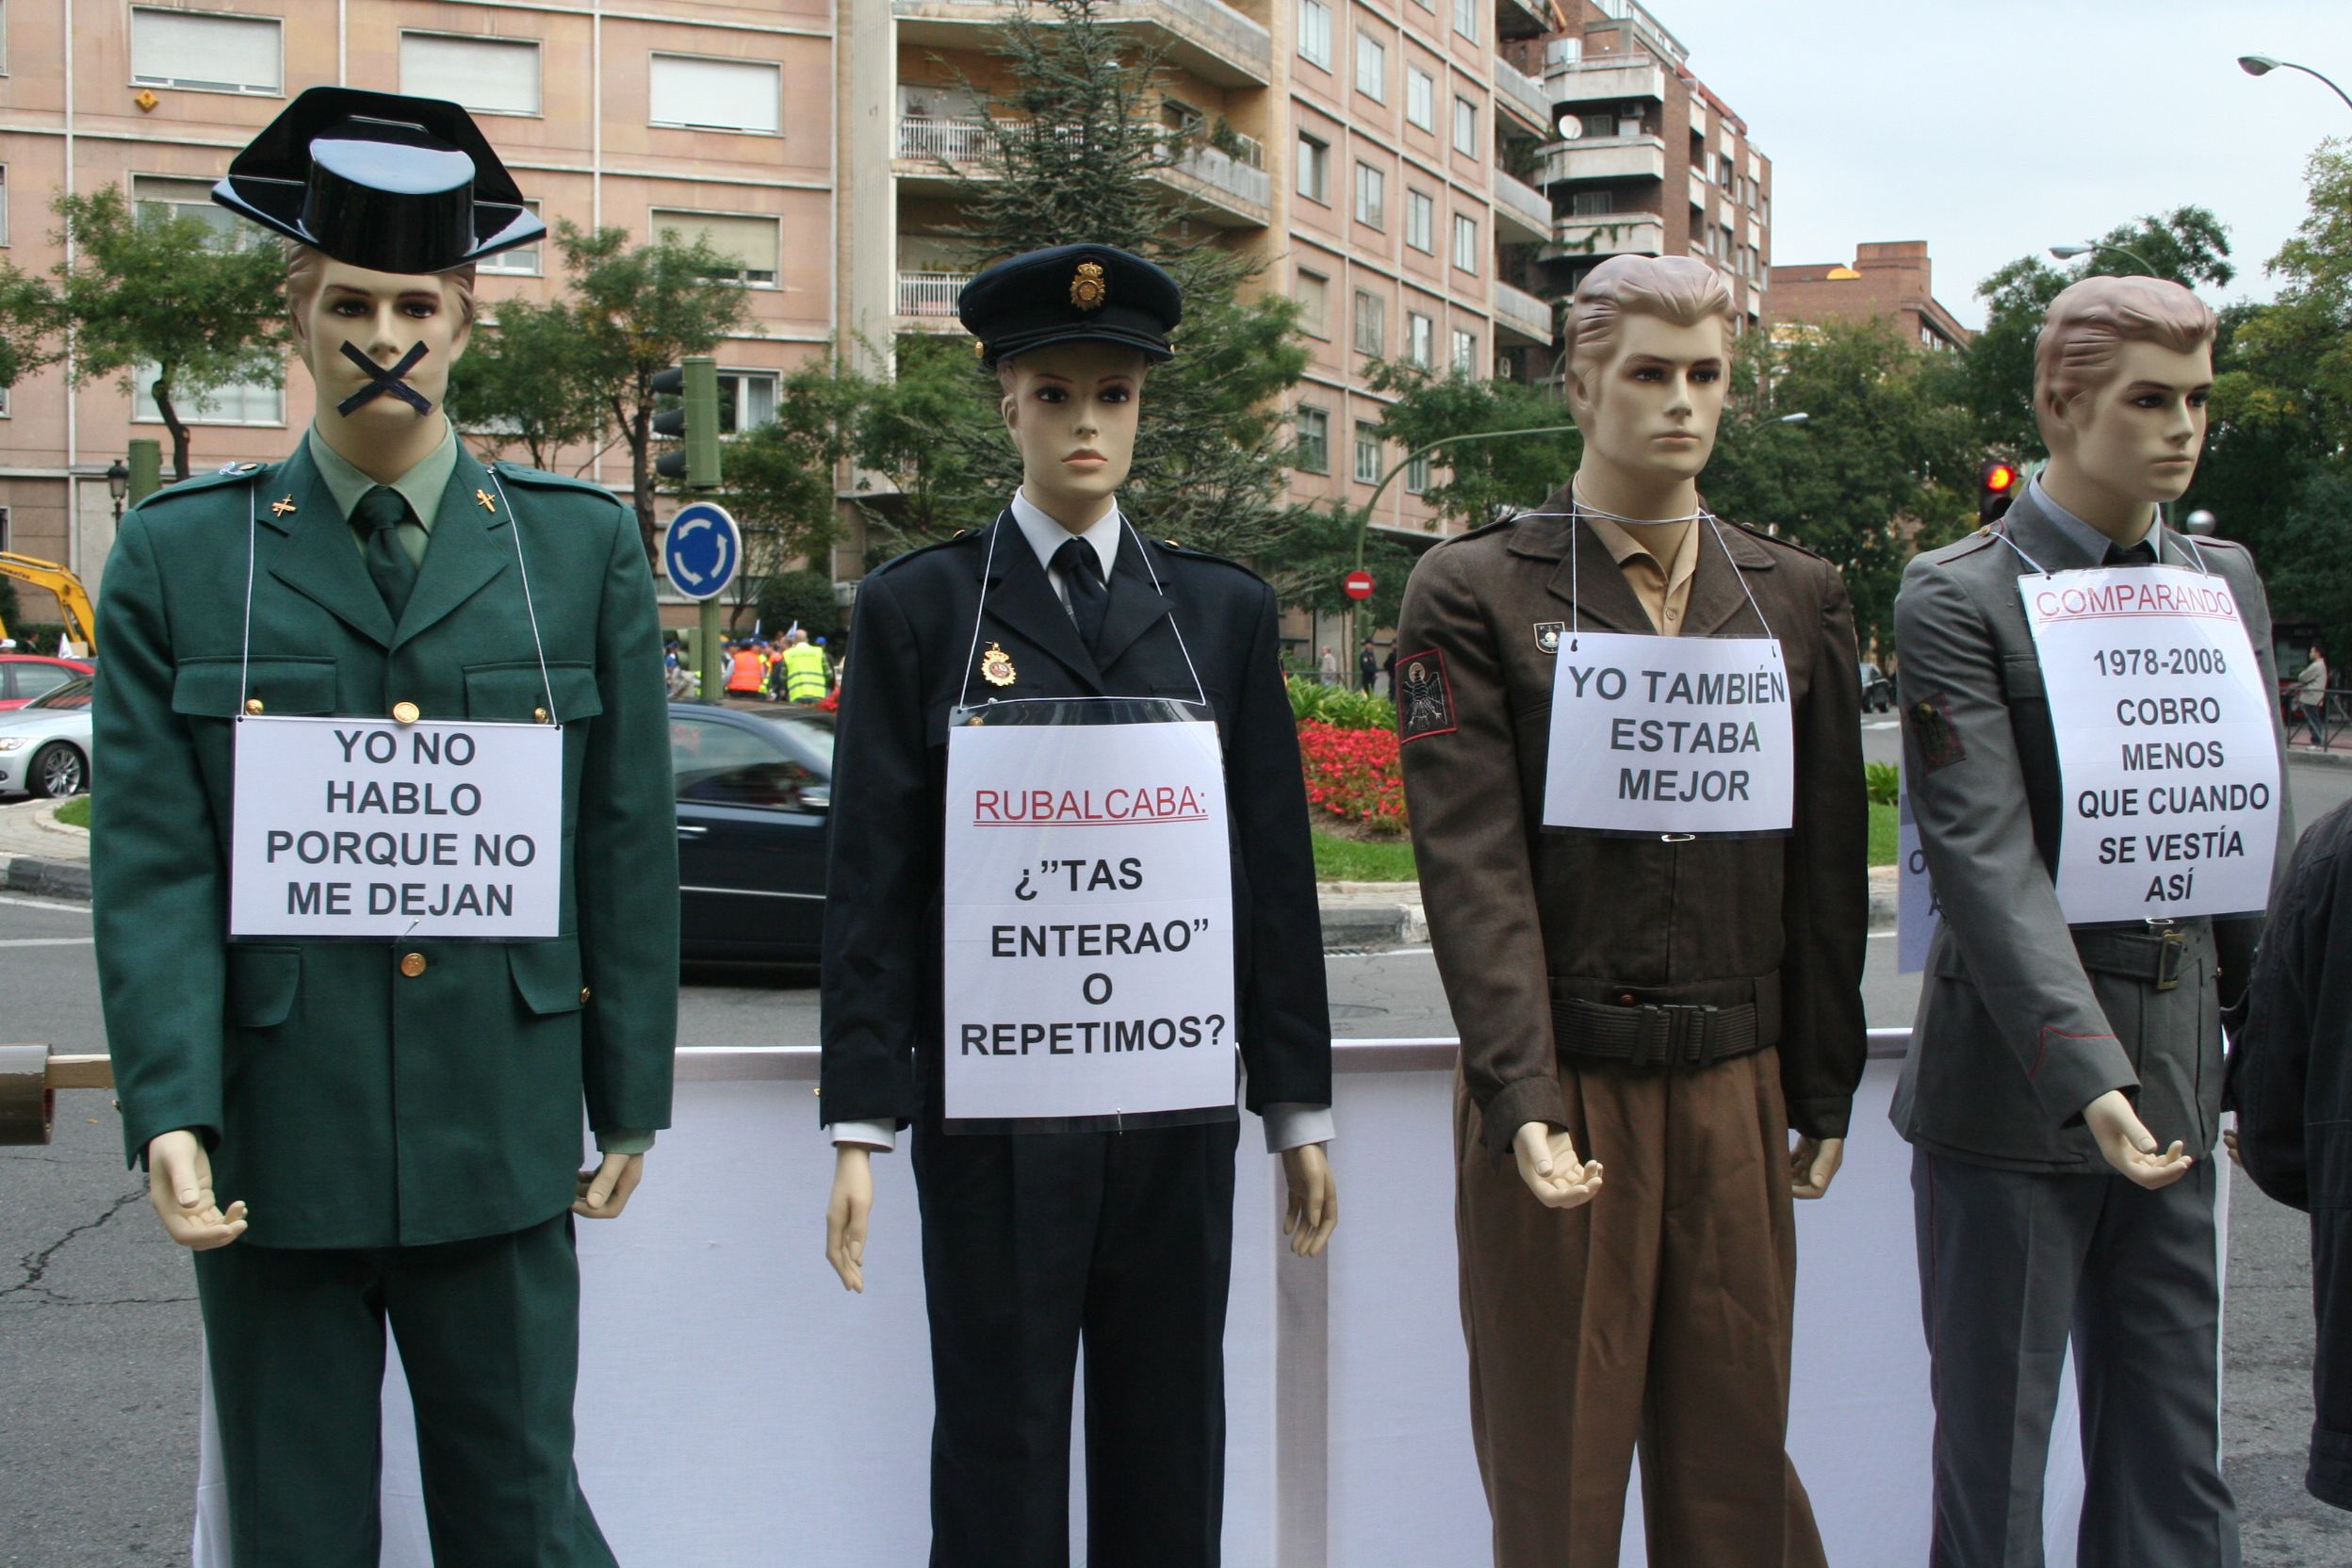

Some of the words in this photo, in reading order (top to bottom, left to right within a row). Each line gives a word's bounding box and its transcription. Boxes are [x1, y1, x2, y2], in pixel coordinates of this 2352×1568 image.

[2036, 583, 2233, 617] COMPARANDO
[2093, 648, 2227, 677] 1978-2008
[1568, 665, 1627, 701] YO
[1642, 664, 1786, 705] TAMBIÉN
[2116, 696, 2220, 727] COBRO
[334, 729, 397, 764] YO
[413, 731, 476, 766] NO
[1610, 717, 1761, 754] ESTABA
[2122, 741, 2225, 772] MENOS
[327, 780, 482, 817] HABLO
[974, 785, 1207, 822] RUBALCABA:
[1618, 767, 1751, 803] MEJOR
[2078, 789, 2139, 820] QUE
[2148, 782, 2270, 815] CUANDO
[267, 830, 458, 868] PORQUE
[474, 833, 536, 867] NO
[2098, 836, 2137, 865] SE
[2144, 825, 2246, 862] VESTÍA
[287, 881, 352, 915] ME
[368, 882, 514, 918] DEJAN
[2144, 867, 2195, 903] ASÍ
[1082, 972, 1113, 1005] O
[961, 1013, 1226, 1057] REPETIMOS?
